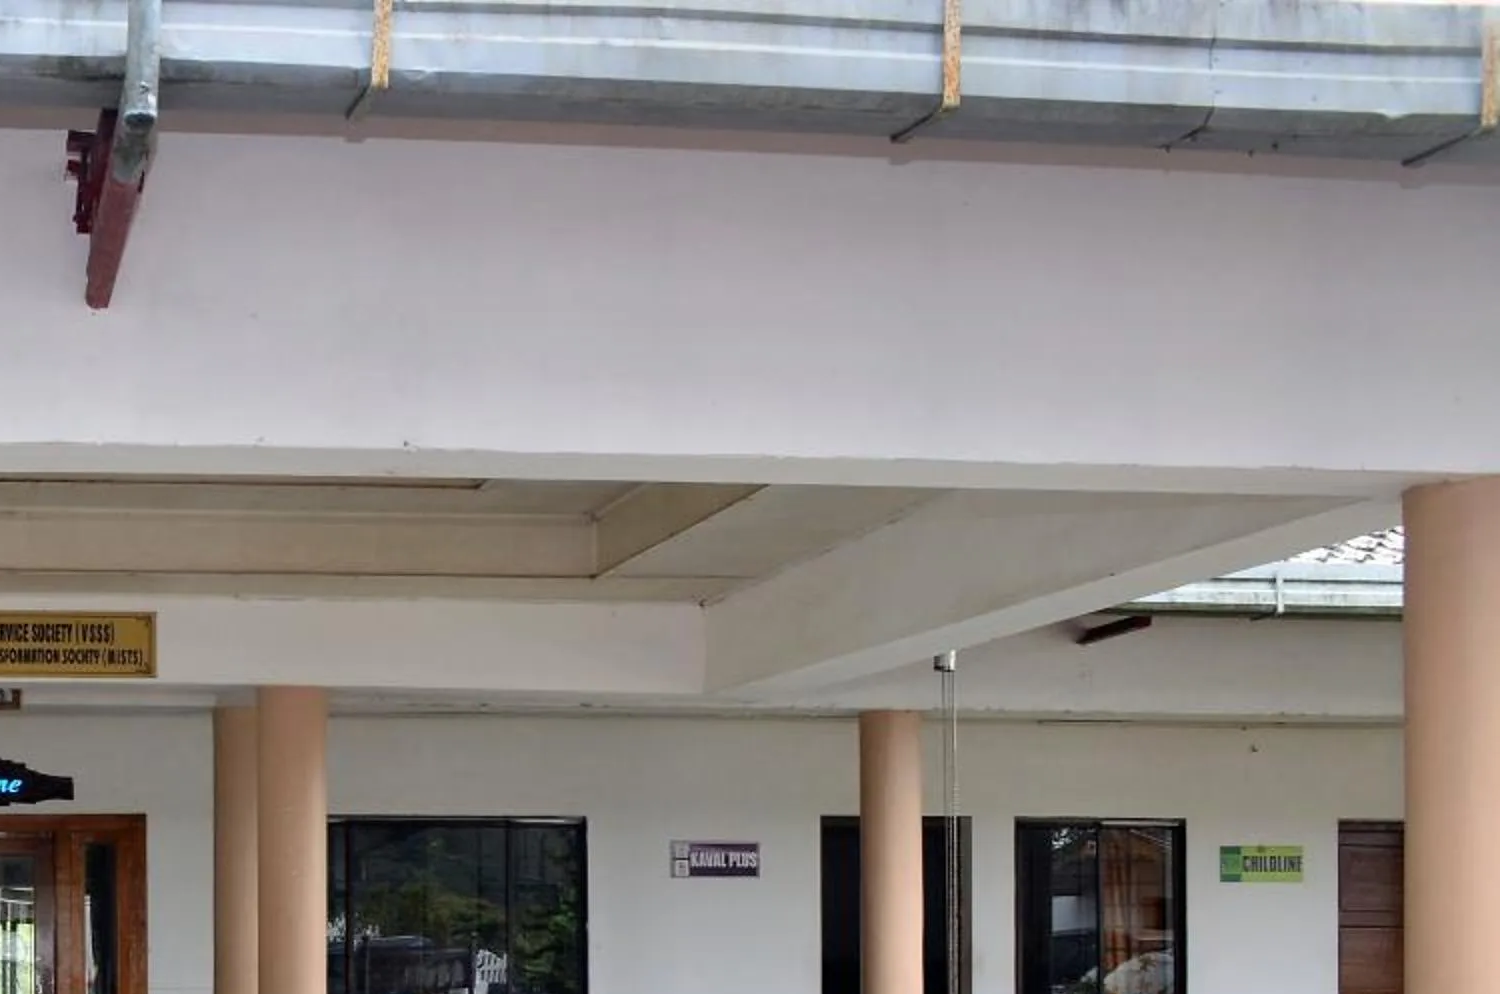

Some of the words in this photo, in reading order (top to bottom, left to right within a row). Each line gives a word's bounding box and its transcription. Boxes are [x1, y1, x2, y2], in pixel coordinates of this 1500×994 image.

[31, 623, 73, 643] SOCIETY
[61, 648, 100, 664] SOCIETY
[690, 851, 726, 868] KAVAL
[729, 851, 757, 868] PLUS
[1243, 855, 1303, 873] CHILDLINE
